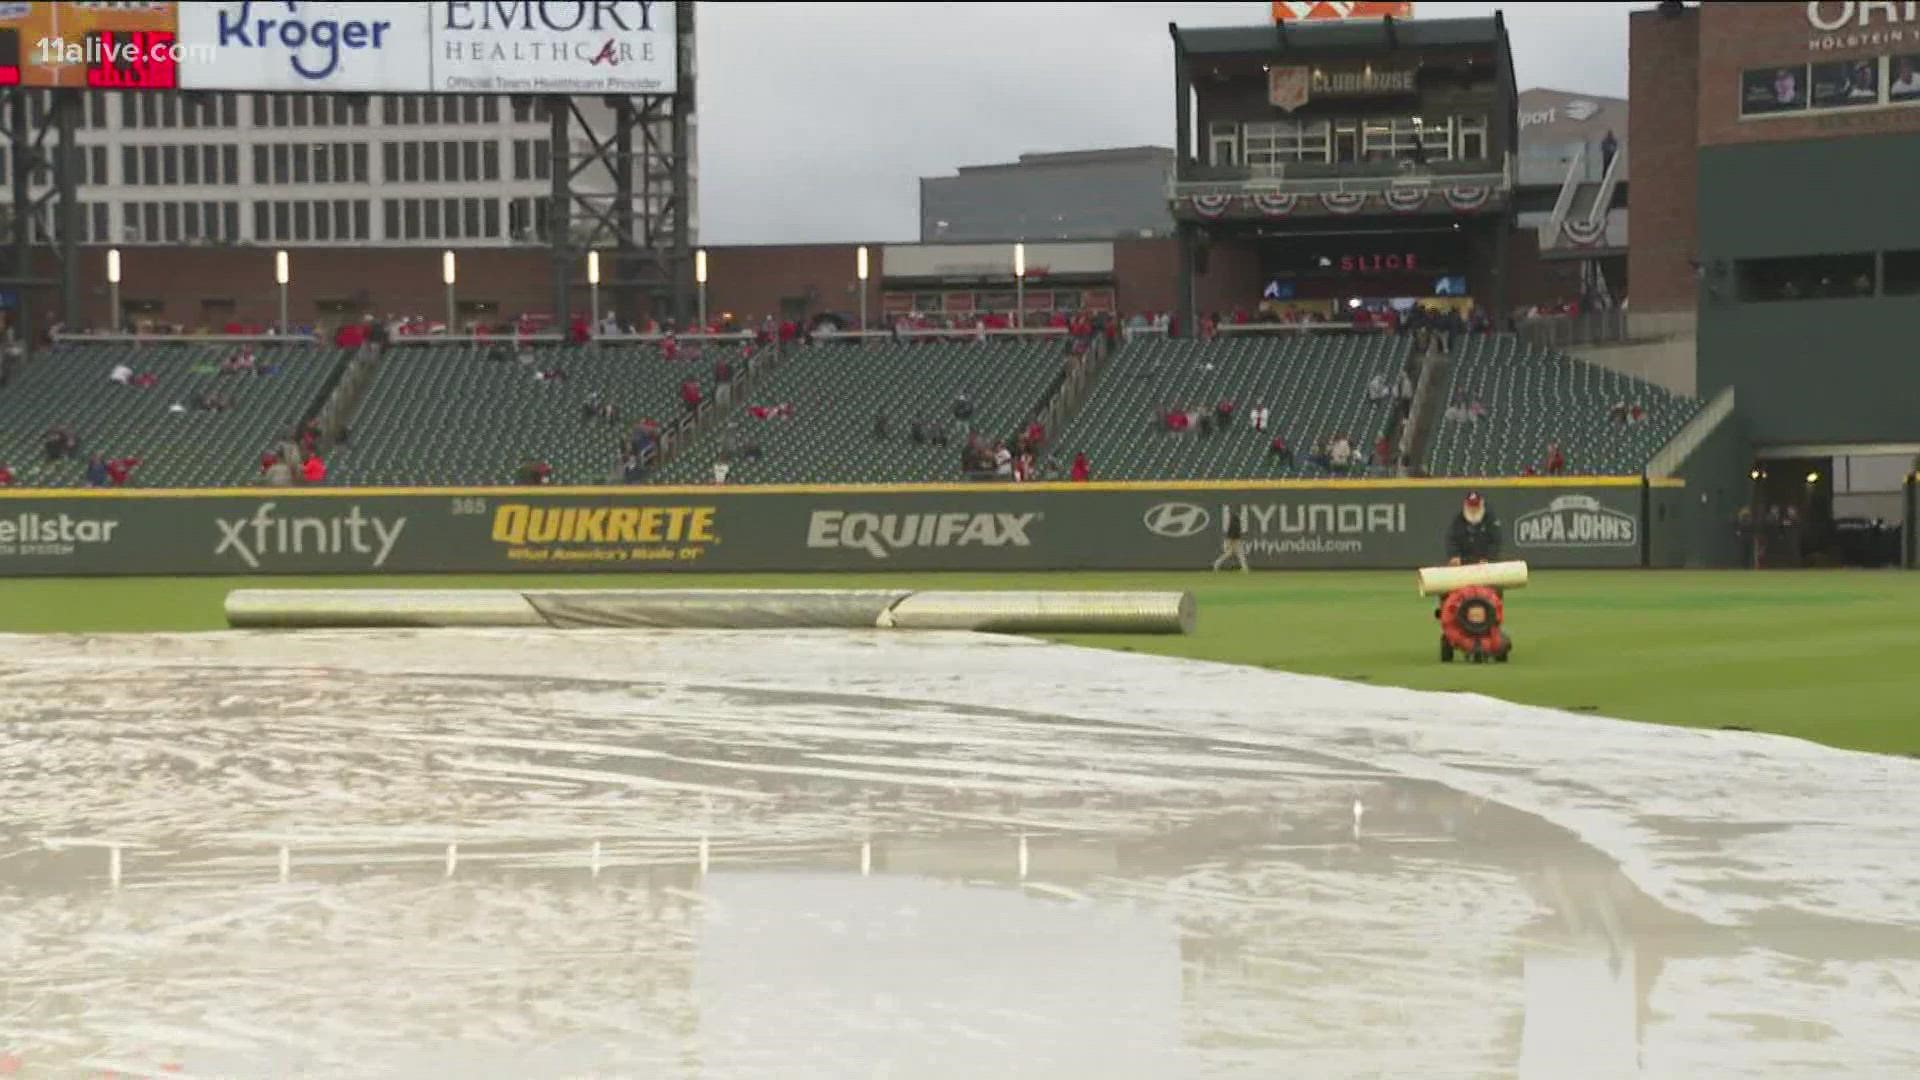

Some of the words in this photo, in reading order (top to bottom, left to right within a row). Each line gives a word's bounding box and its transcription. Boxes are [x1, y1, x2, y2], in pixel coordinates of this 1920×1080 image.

[446, 1, 658, 31] EMORY
[219, 2, 391, 79] Kroger
[446, 38, 656, 66] HEALTHCARE
[1312, 70, 1414, 92] CLUBHOUSE
[1518, 107, 1556, 130] port
[491, 504, 717, 545] QUIKRETE
[1221, 503, 1406, 533] HYUNDAI
[1519, 512, 1566, 541] PAPA
[214, 503, 407, 568] xfinity
[806, 510, 1034, 559] EQUIFAX
[1223, 536, 1363, 556] yHyundai.com
